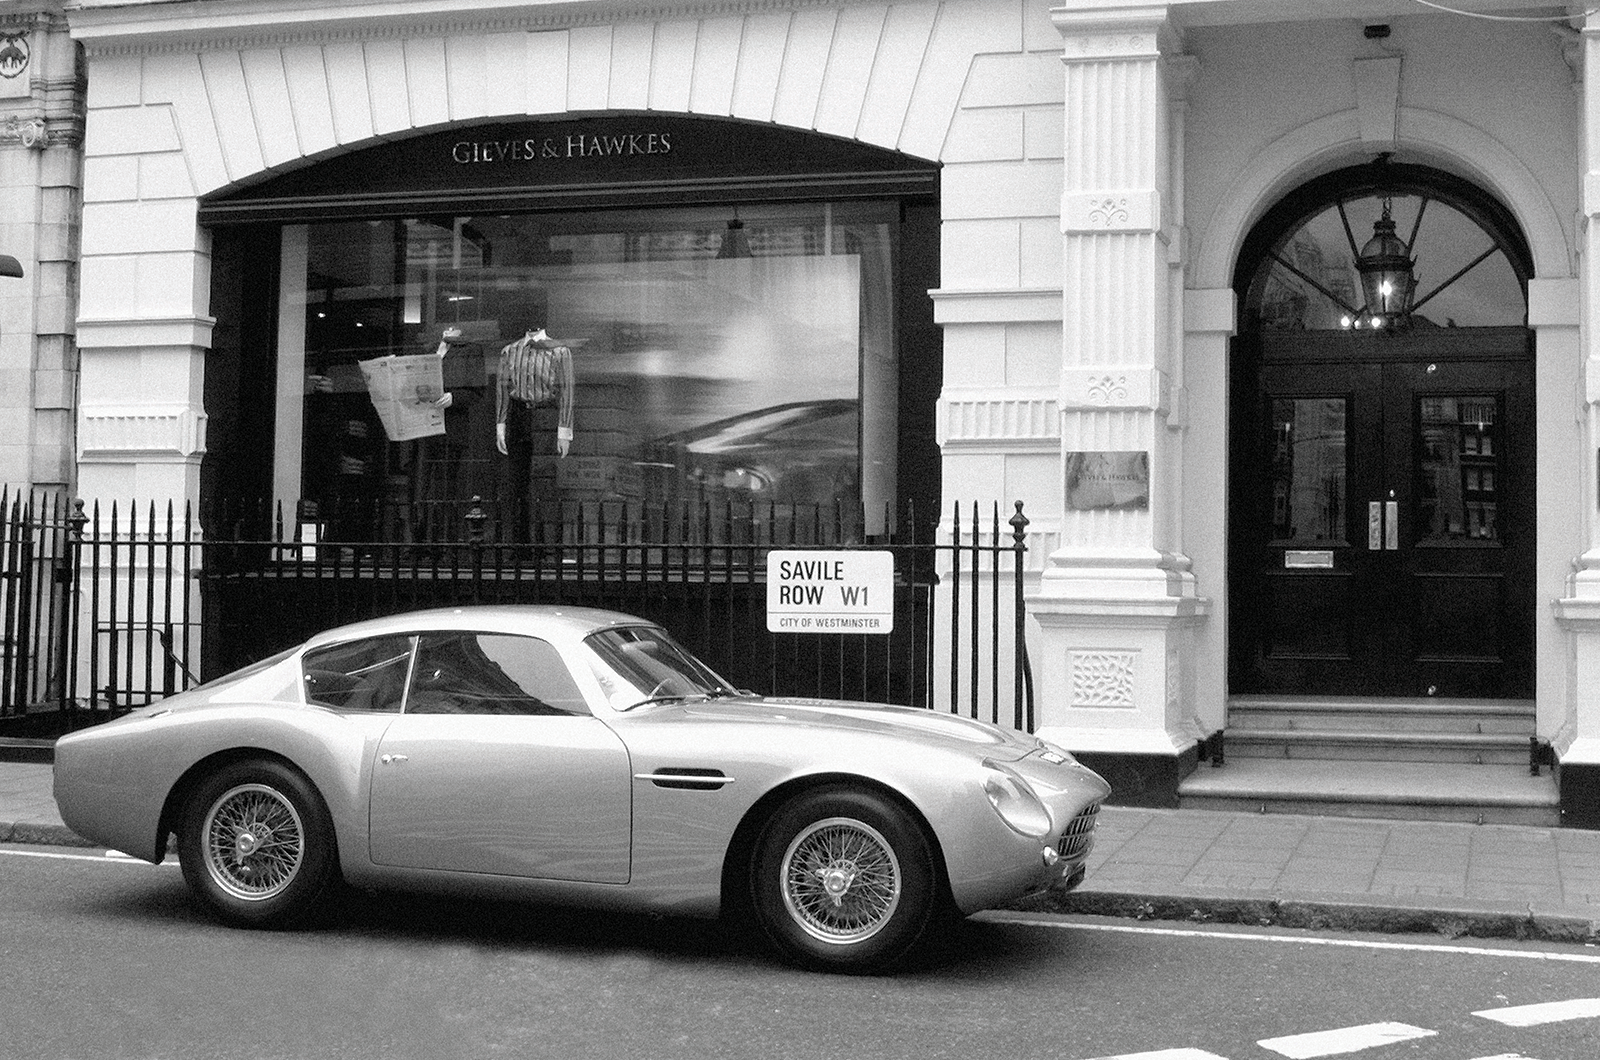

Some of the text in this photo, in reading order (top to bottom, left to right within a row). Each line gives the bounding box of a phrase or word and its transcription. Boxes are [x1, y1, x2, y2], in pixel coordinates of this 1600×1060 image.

[452, 133, 672, 163] GIEVES & HAWKES
[780, 560, 844, 580] SAVILE
[780, 585, 868, 606] ROW W1
[780, 618, 880, 628] CITY OF WESTMINSTER
